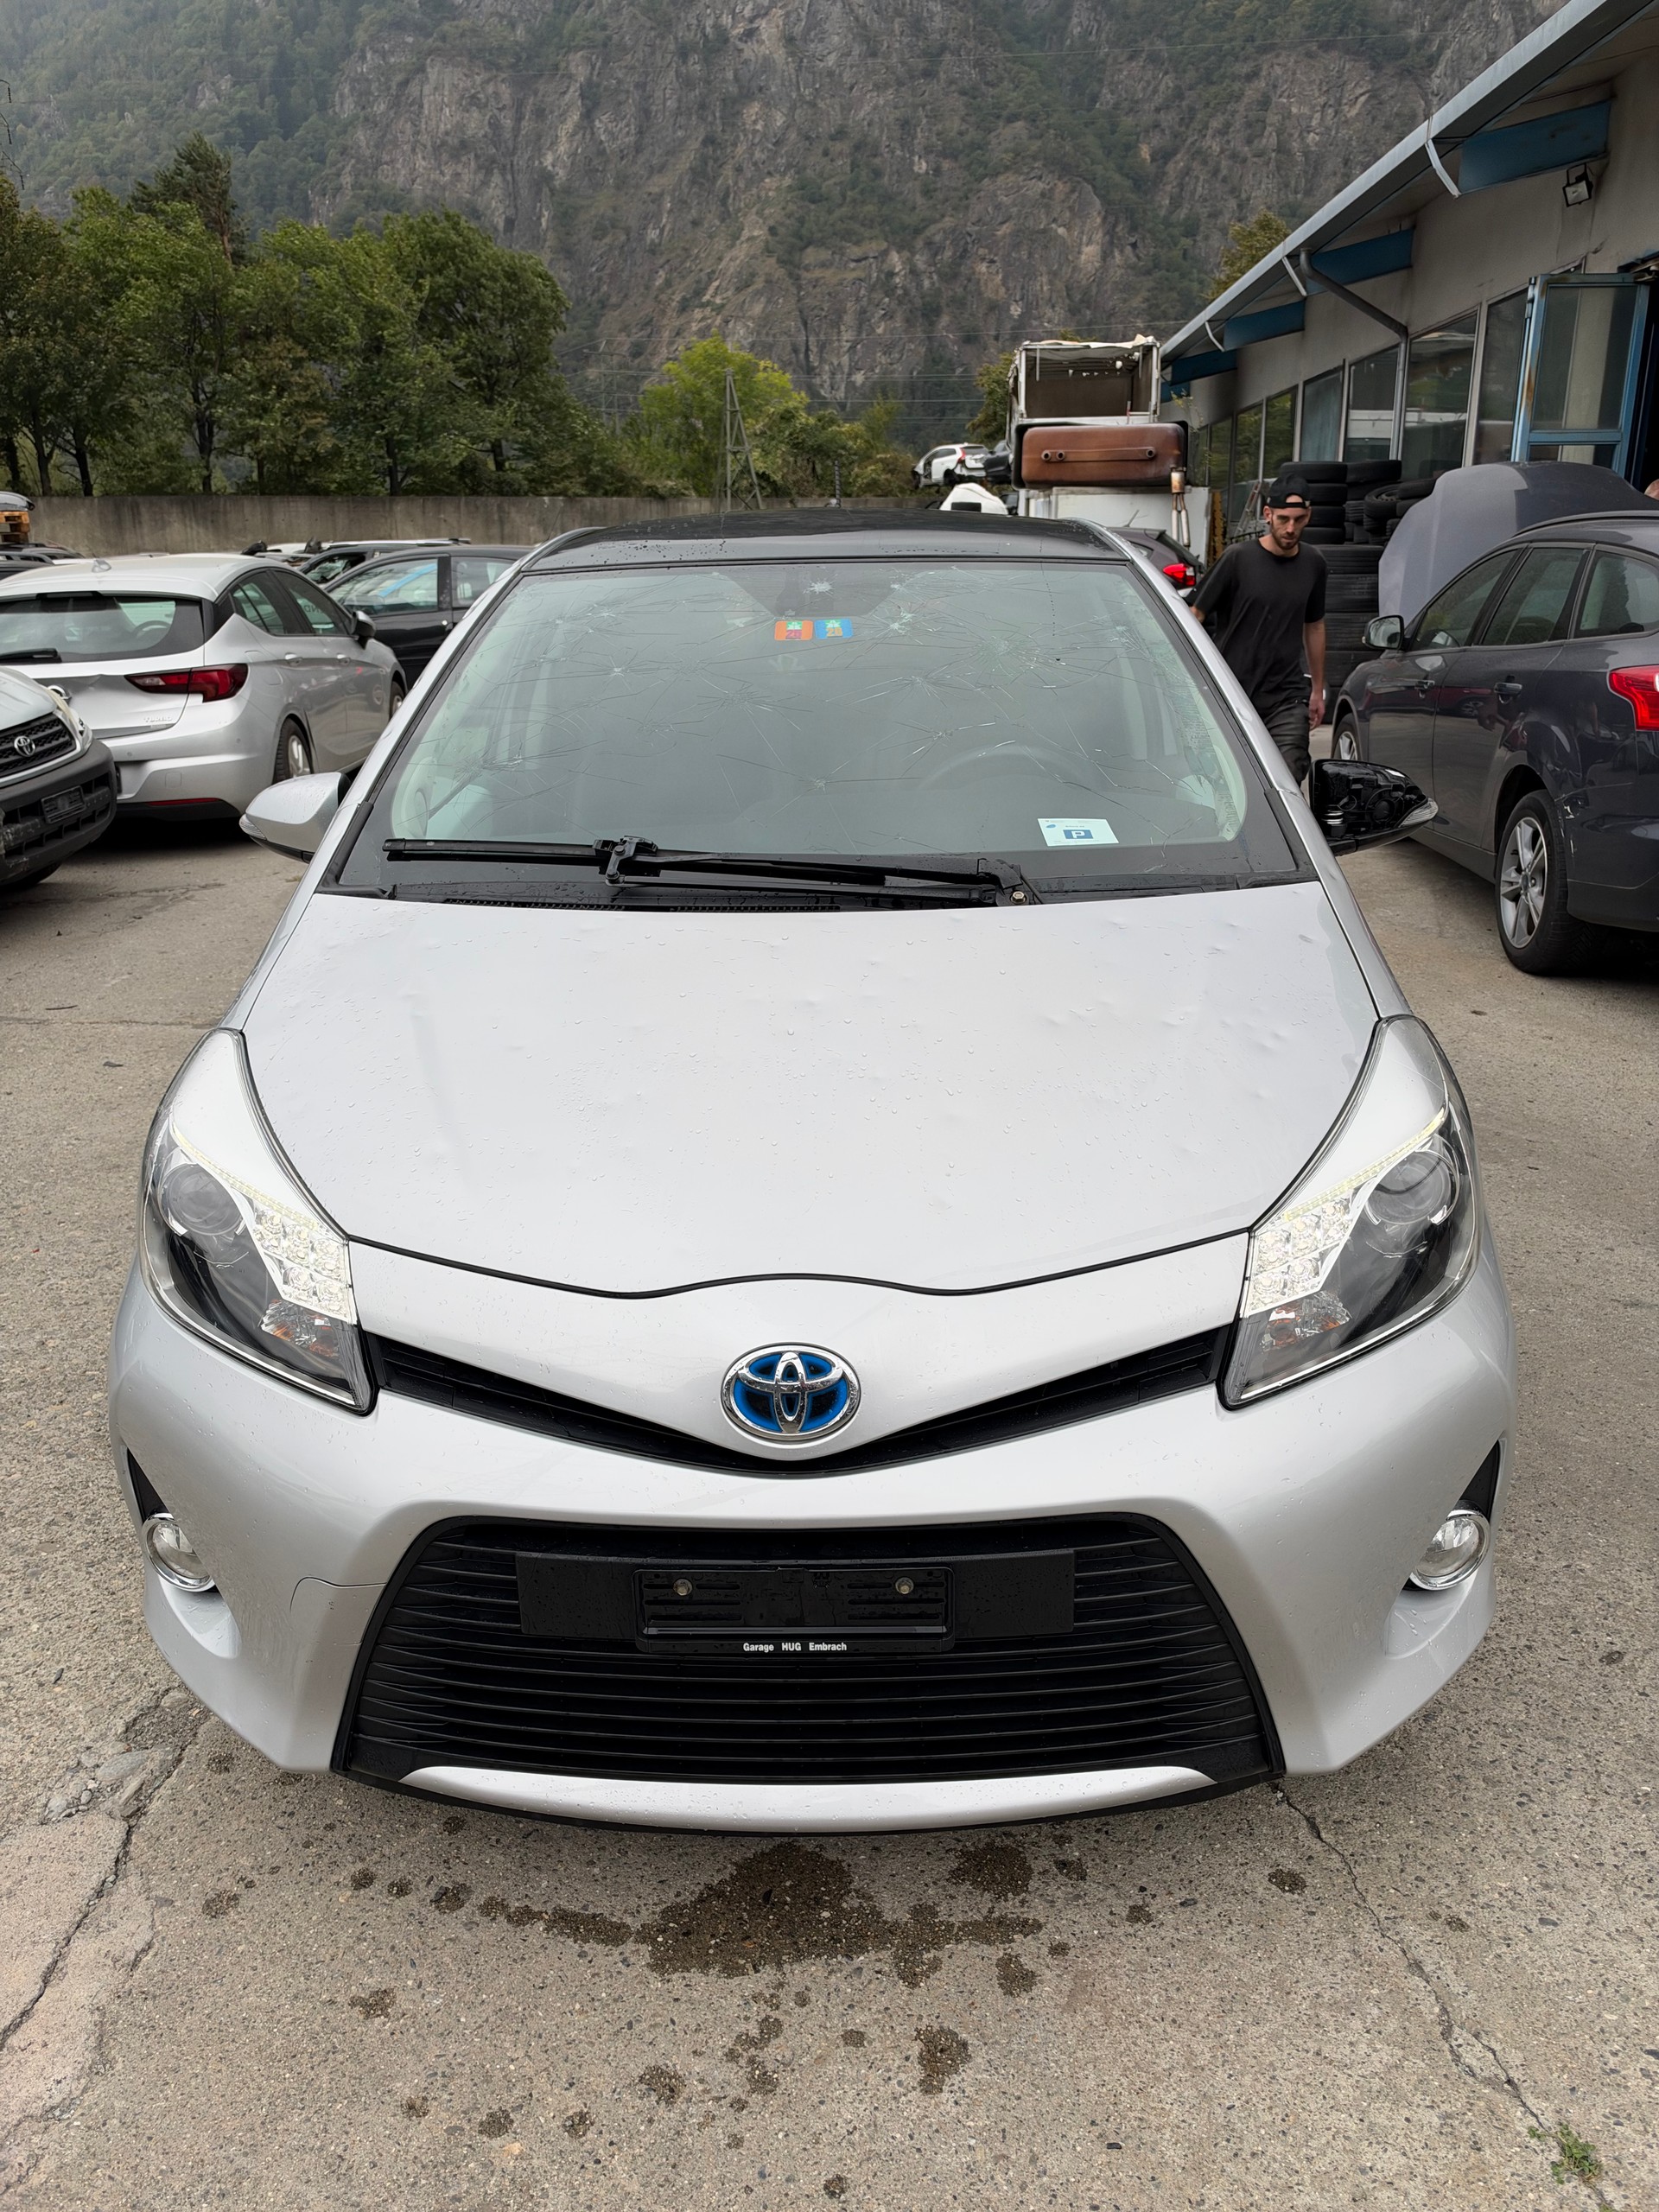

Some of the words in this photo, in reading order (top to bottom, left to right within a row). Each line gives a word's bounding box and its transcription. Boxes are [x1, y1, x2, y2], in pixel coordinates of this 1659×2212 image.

[1071, 830, 1086, 839] P
[743, 1643, 774, 1653] Garage
[781, 1643, 802, 1651] HUG
[809, 1643, 847, 1651] Embrach
